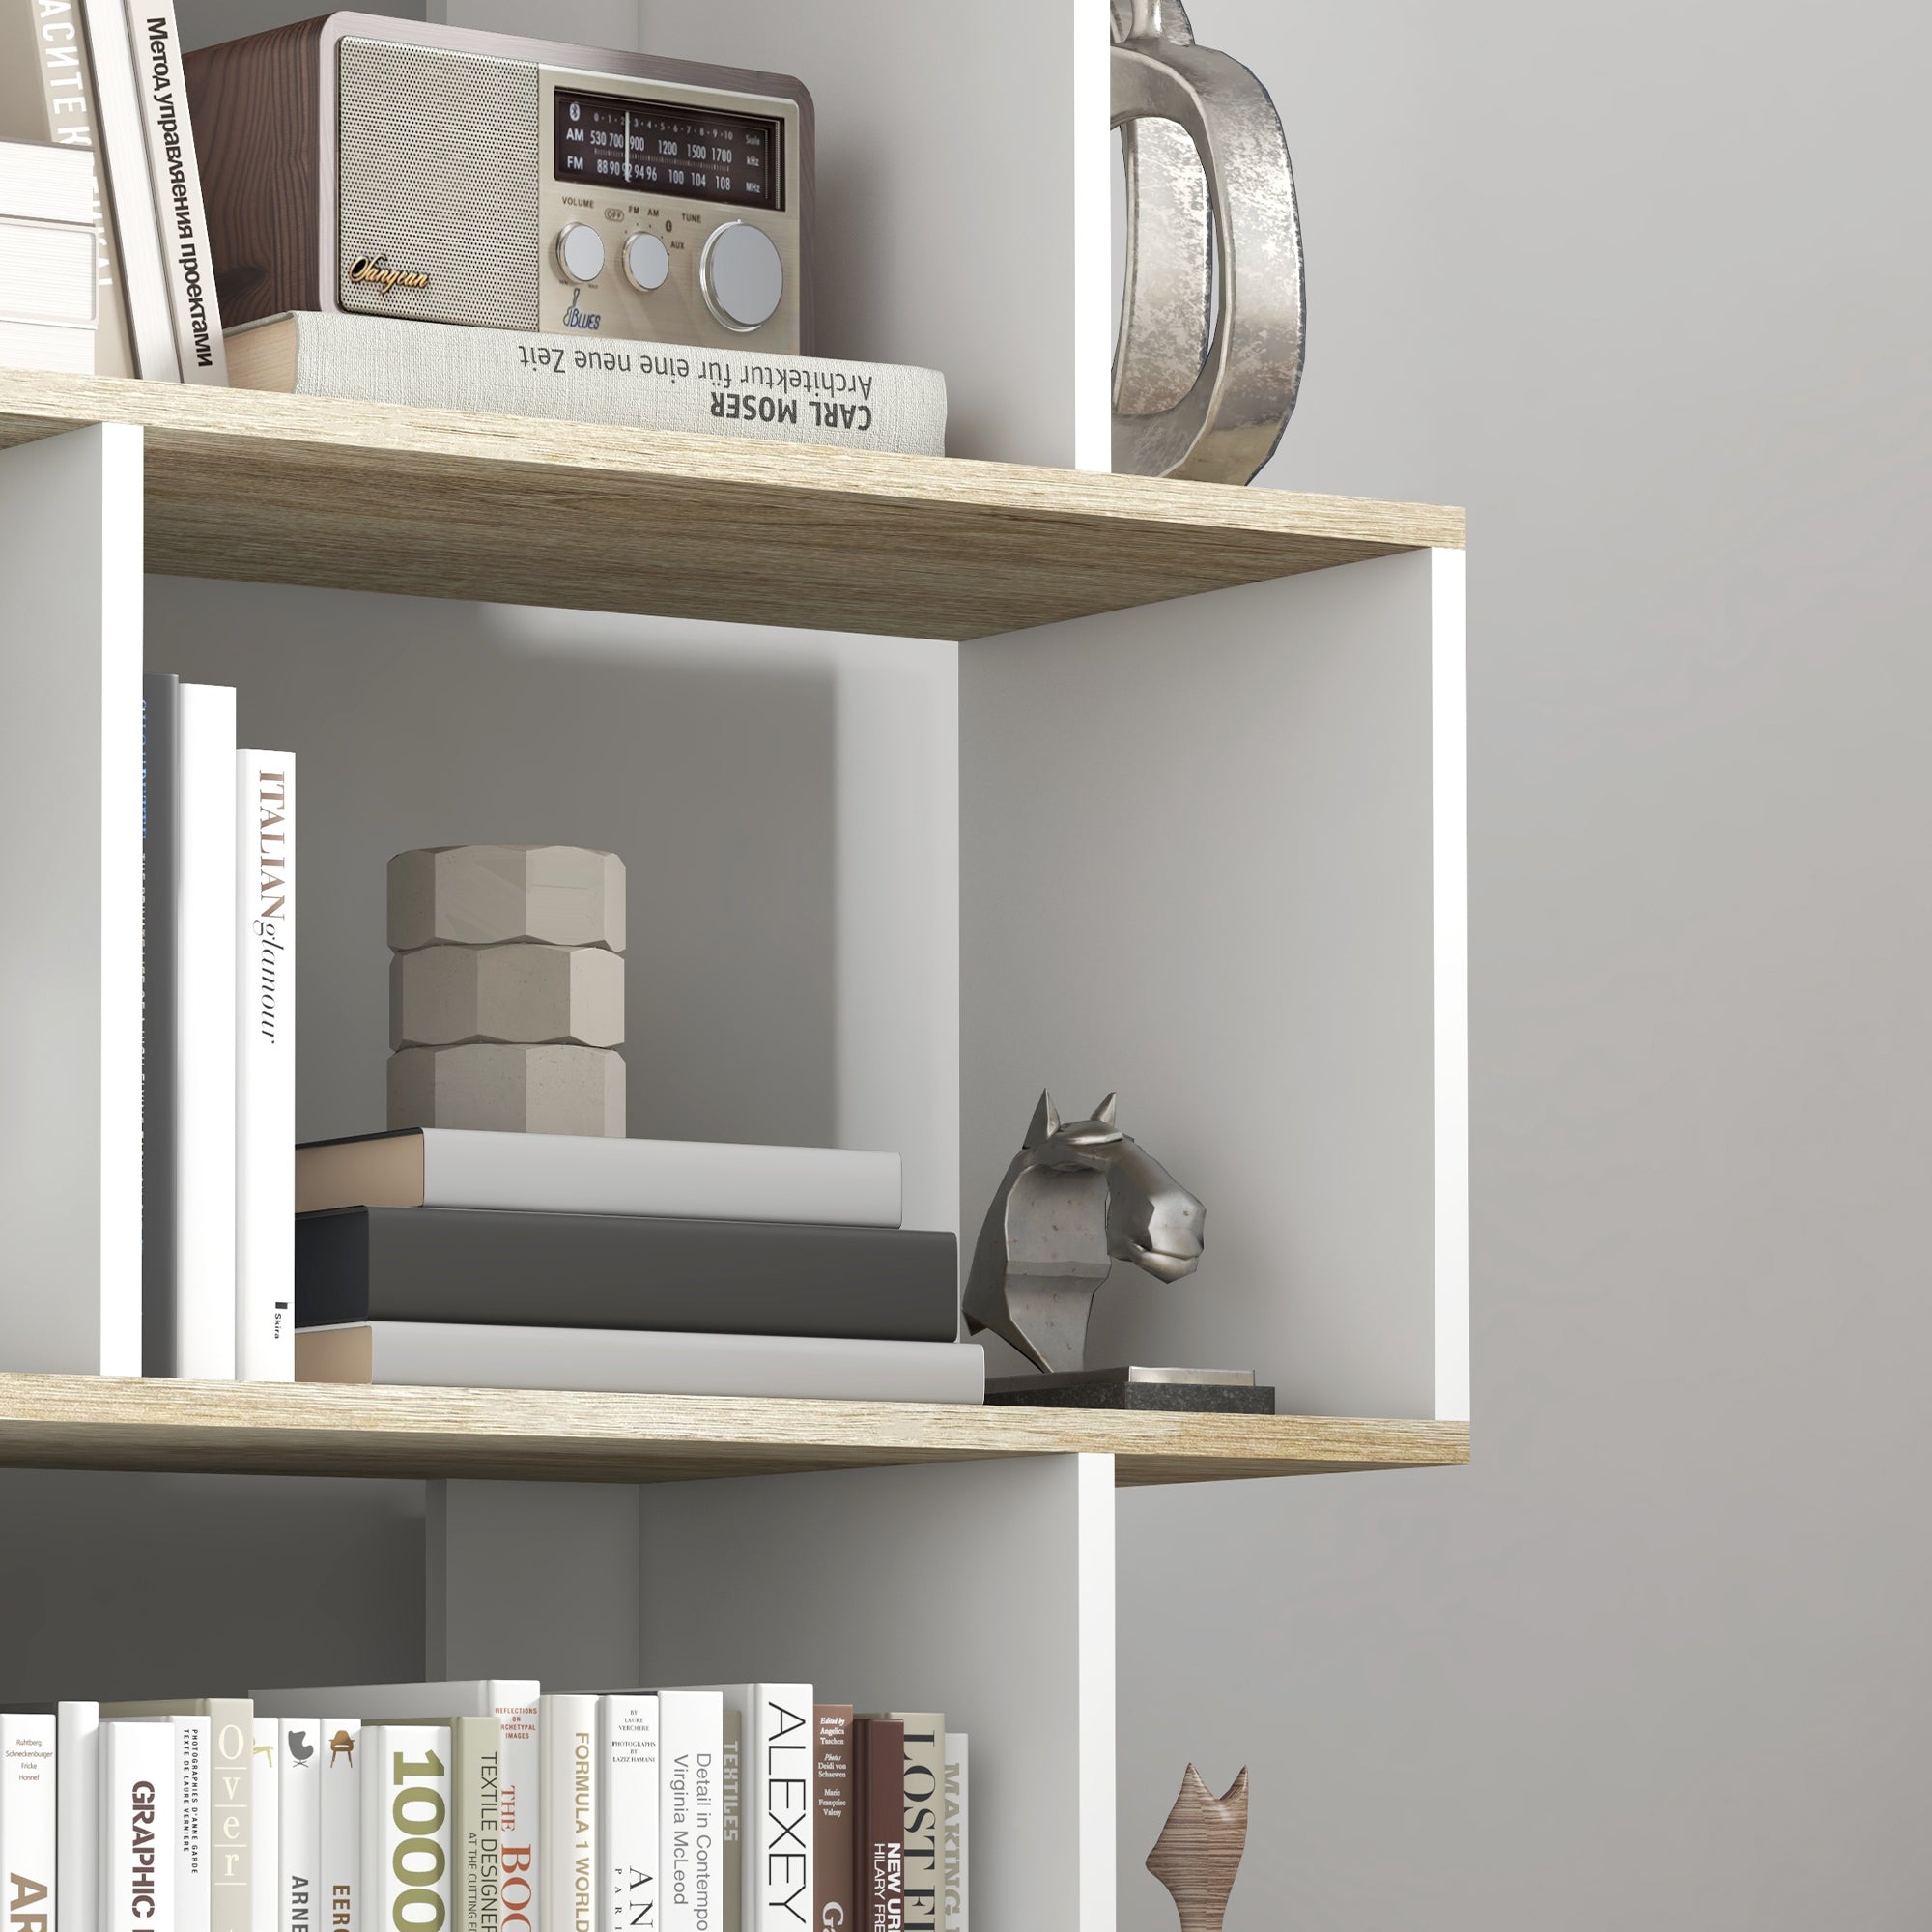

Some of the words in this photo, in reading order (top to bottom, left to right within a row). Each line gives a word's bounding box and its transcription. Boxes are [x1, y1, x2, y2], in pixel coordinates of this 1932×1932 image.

[146, 17, 171, 92] Метод
[566, 127, 584, 142] AM
[589, 130, 607, 146] 530
[609, 133, 624, 148] 700
[629, 136, 645, 152] 900
[658, 139, 678, 156] 1200
[687, 143, 706, 159] 1500
[712, 147, 732, 163] 1700
[746, 156, 759, 167] kHz
[634, 118, 639, 127] 3
[646, 120, 652, 129] 4
[660, 122, 666, 131] 5
[687, 125, 692, 134] 7
[699, 127, 704, 136] 8
[713, 128, 718, 138] 9
[724, 130, 733, 140] 10
[154, 93, 193, 240] управления
[567, 156, 583, 170] FM
[597, 159, 608, 174] 88
[609, 161, 620, 176] 90
[634, 164, 645, 179] 94
[646, 166, 657, 181] 96
[668, 169, 684, 185] 100
[691, 172, 706, 187] 104
[715, 175, 730, 190] 108
[746, 182, 760, 193] MHz
[562, 196, 595, 209] VOLUME
[607, 210, 622, 219] OFF
[629, 205, 639, 214] FM
[647, 208, 660, 217] AM
[682, 213, 701, 223] TUNE
[670, 241, 685, 249] AUX
[179, 243, 213, 368] проектами
[518, 345, 566, 374] Zeit
[575, 349, 631, 372] neue
[640, 355, 689, 384] eine
[698, 361, 731, 388] für
[740, 364, 872, 401] Architektur
[710, 391, 798, 425] MOSER
[809, 400, 872, 431] CARL
[259, 769, 285, 920] ITALIAN
[820, 1727, 844, 1737] Angelica
[838, 1718, 845, 1726] by
[183, 1760, 189, 1772] DE
[575, 1732, 589, 1834] FORMULA
[696, 1753, 711, 1805] Detail
[481, 1751, 497, 1832] TEXTILE
[501, 1785, 516, 1832] THE
[669, 1754, 689, 1824] Virginia
[724, 1740, 738, 1841] TEXTILES
[904, 1730, 935, 1871] LOST
[696, 1812, 711, 1828] in
[769, 1701, 806, 1924] ALEXEY
[823, 1808, 841, 1817] Valery
[131, 1780, 155, 1918] GRAPHIC
[392, 1749, 446, 1932] 1000
[468, 1832, 477, 1845] AT
[944, 1762, 961, 1916] MAKING
[468, 1850, 477, 1870] THE
[673, 1831, 689, 1905] McLeod
[874, 1843, 886, 1900] HILARY
[887, 1842, 901, 1893] NEW
[291, 1875, 309, 1932] ARNE
[468, 1873, 477, 1918] CUTTING
[575, 1857, 589, 1932] WORLD
[694, 1834, 711, 1931] Contempo
